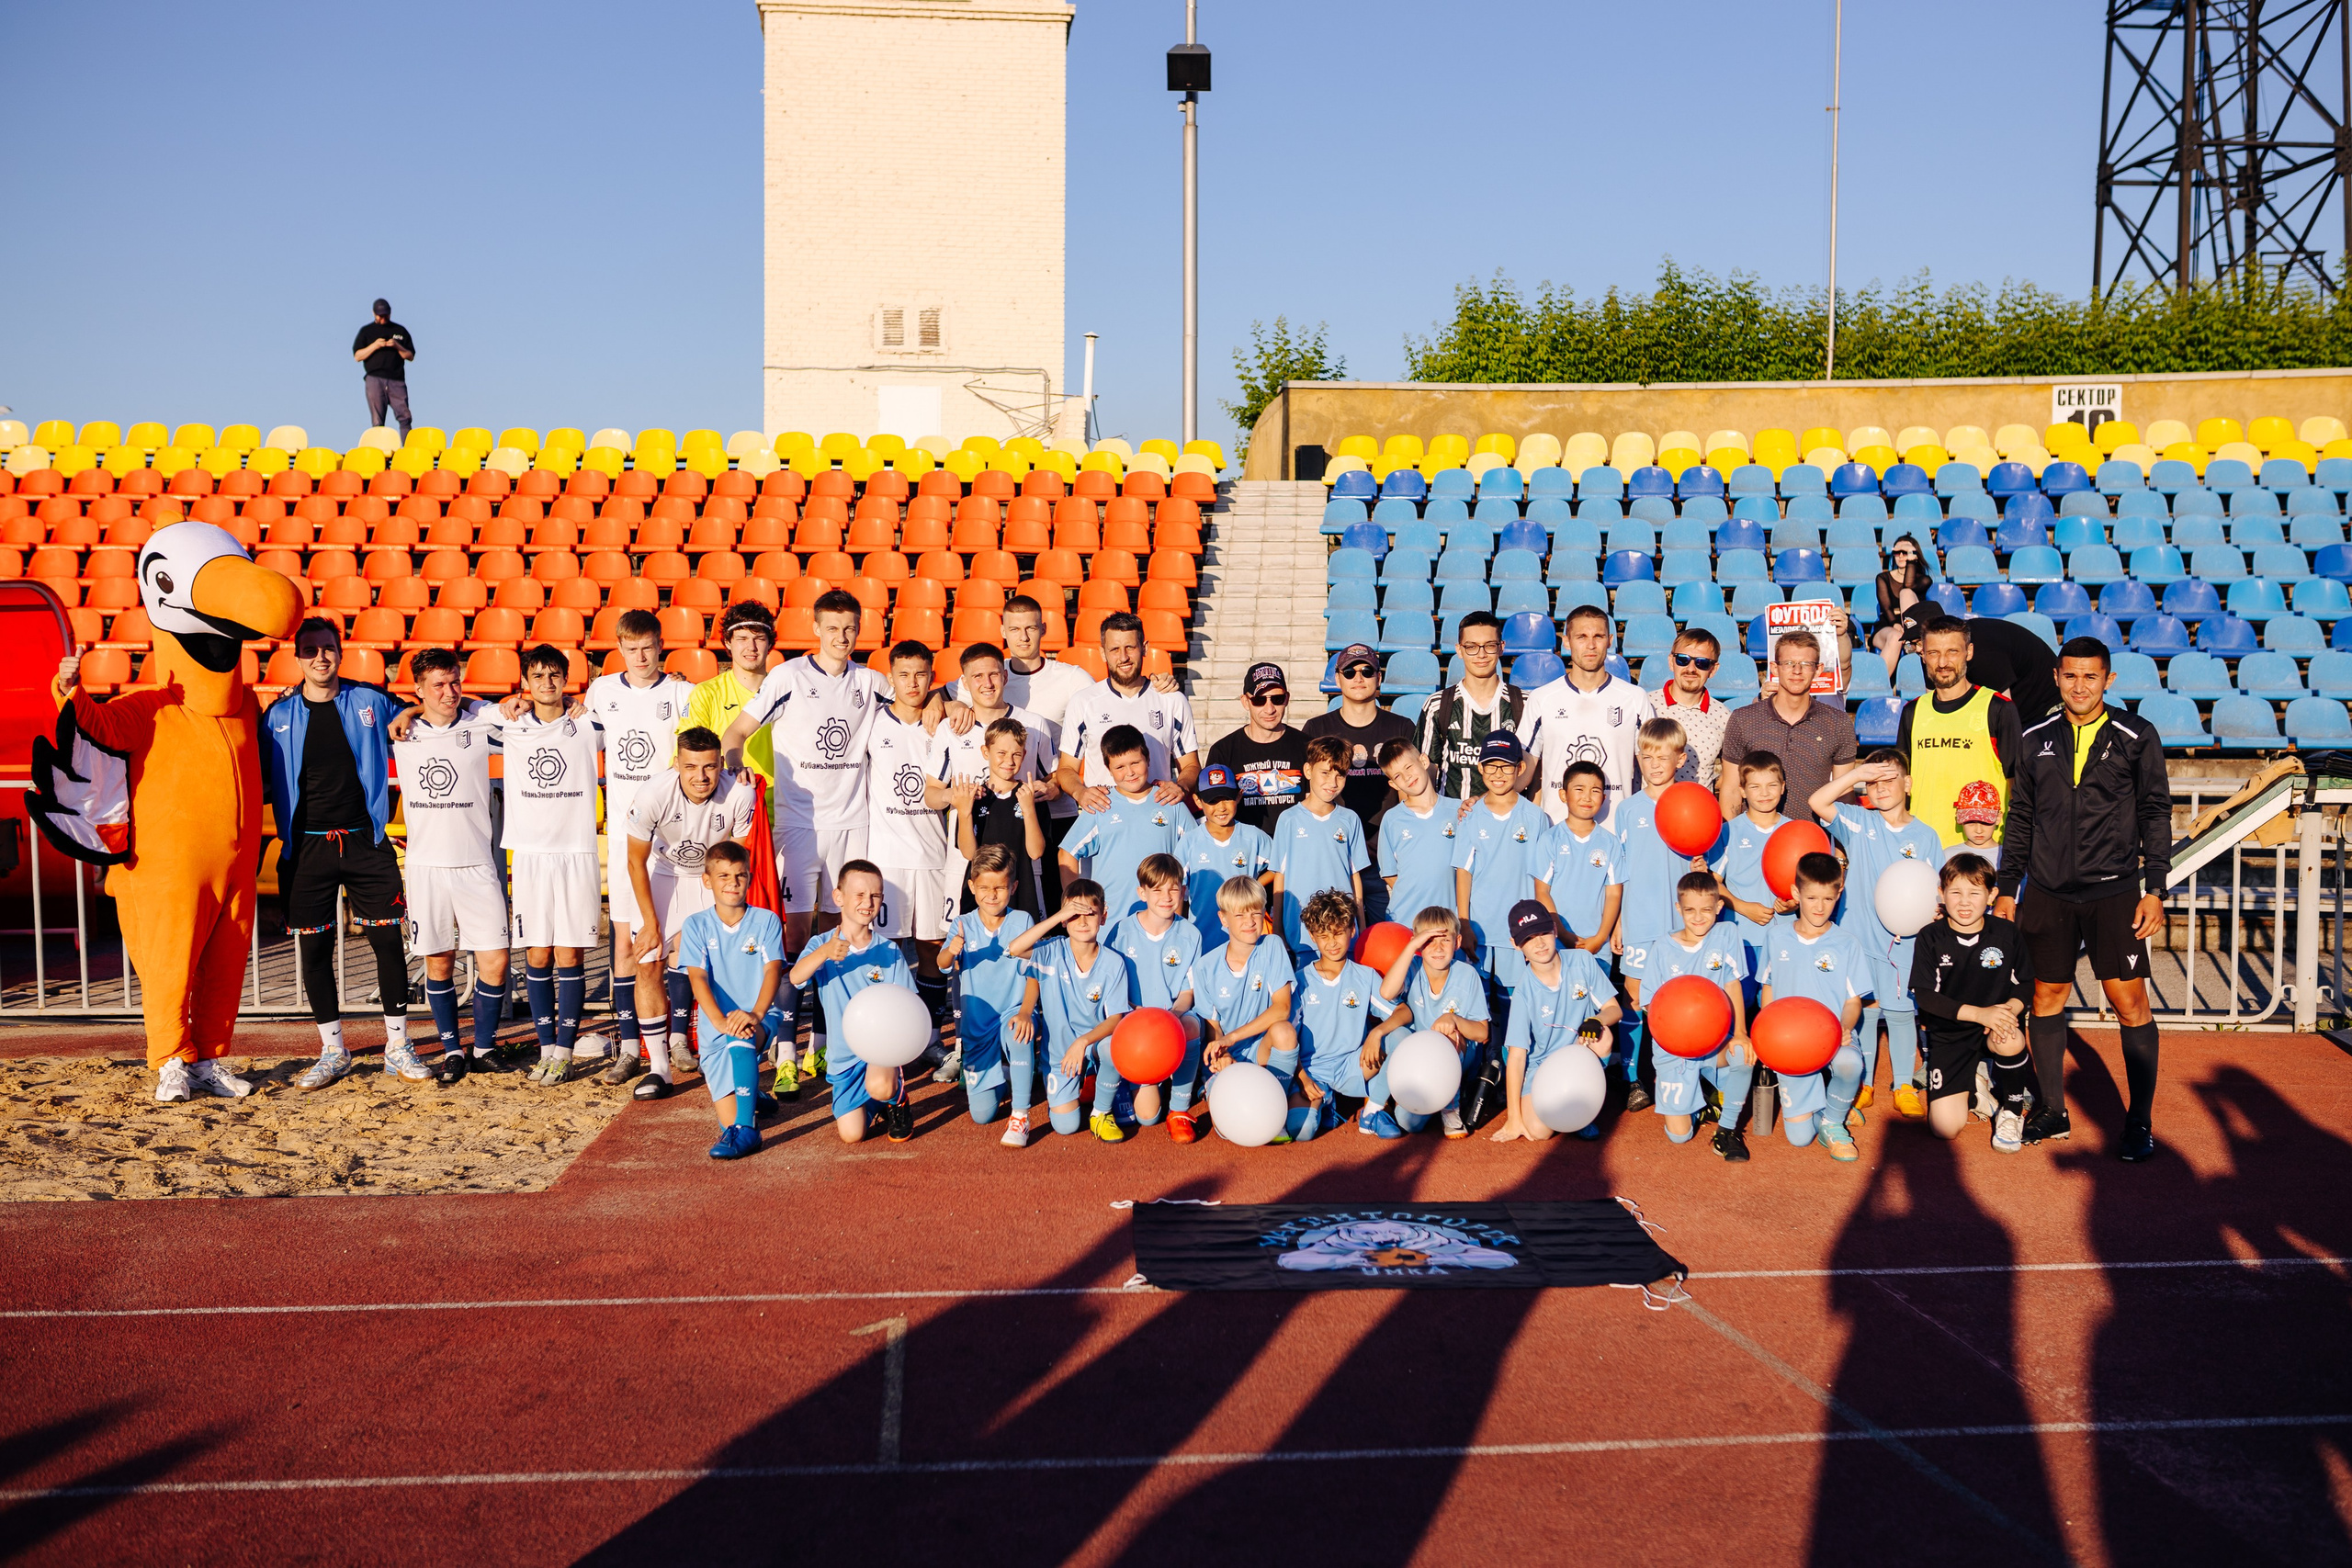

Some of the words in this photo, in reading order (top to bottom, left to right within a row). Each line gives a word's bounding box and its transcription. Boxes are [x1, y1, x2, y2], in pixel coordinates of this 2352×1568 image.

[2058, 389, 2116, 406] СЕКТОР
[1771, 605, 1831, 624] ФУТБОЛ
[1917, 738, 1962, 750] KELME
[1243, 759, 1272, 773] ЮЖНЫЙ
[1272, 761, 1291, 770] УРАЛ
[410, 801, 474, 810] КубаньЭнергоРемонт
[942, 897, 954, 922] 2
[1518, 913, 1538, 926] FILA
[1625, 946, 1648, 967] 22
[1661, 1082, 1683, 1105] 77
[1260, 1211, 1521, 1247] МАГНИТОГОРСК
